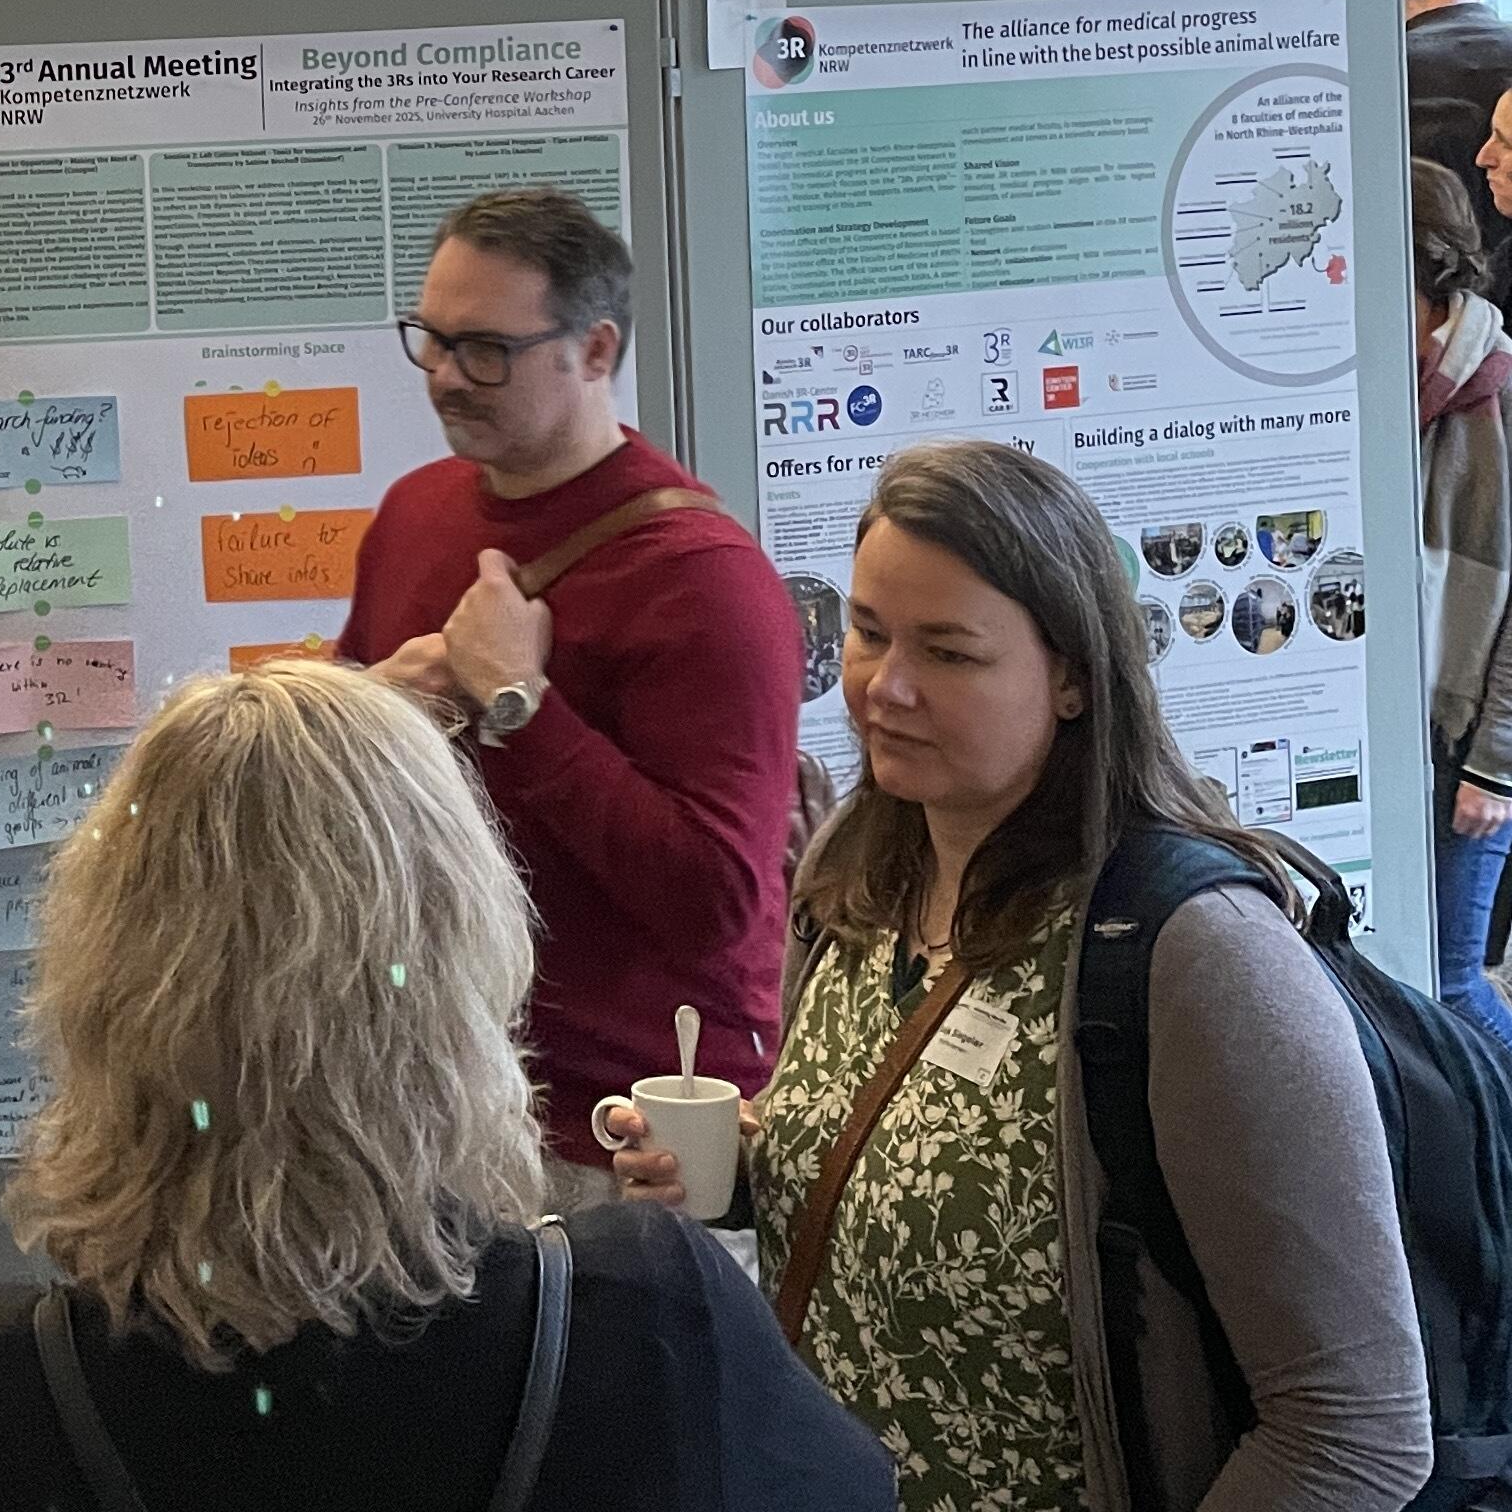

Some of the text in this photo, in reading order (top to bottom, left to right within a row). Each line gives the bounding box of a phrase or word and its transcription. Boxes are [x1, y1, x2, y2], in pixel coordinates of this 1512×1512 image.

[962, 6, 1258, 40] The alliance for medical progress
[302, 36, 582, 76] Beyond Compliance
[776, 37, 806, 60] 3R
[819, 37, 954, 59] Kompetenznetzwerk
[962, 28, 1341, 69] in line with the best possible animal welfare
[0, 49, 257, 85] 3rd Annual Meeting
[819, 60, 851, 74] NRW
[269, 65, 616, 95] Integrating the 3Rs into Your Research Career
[0, 81, 191, 110] Kompetenznetzwerk
[294, 89, 592, 115] Insights from the Pre-Conference Workshop
[1257, 91, 1343, 108] An alliance of the
[0, 108, 44, 126] NRW
[335, 104, 575, 124] November 2025, University Hospital Aachen
[755, 109, 835, 129] About us
[1240, 111, 1284, 124] faculties
[1285, 109, 1297, 121] of
[1298, 108, 1343, 120] medicine
[1214, 122, 1343, 141] in North Rhine-Westphalia
[1289, 202, 1314, 216] 18.2
[761, 308, 920, 336] Our collaborators
[201, 341, 346, 359] Brainstorming Space
[32, 402, 113, 448] funding?
[202, 404, 339, 448] rejection of
[1074, 407, 1352, 450] Building a dialog with many more
[232, 441, 279, 469] ideas
[766, 454, 854, 479] Offers for
[1075, 447, 1215, 473] Cooperation with local schools
[766, 489, 801, 502] Events
[216, 518, 348, 553] failure to
[13, 551, 76, 573] relative
[224, 564, 274, 588] share
[30, 655, 44, 667] is
[56, 656, 73, 667] no
[29, 759, 44, 791] of
[50, 752, 102, 778] animals
